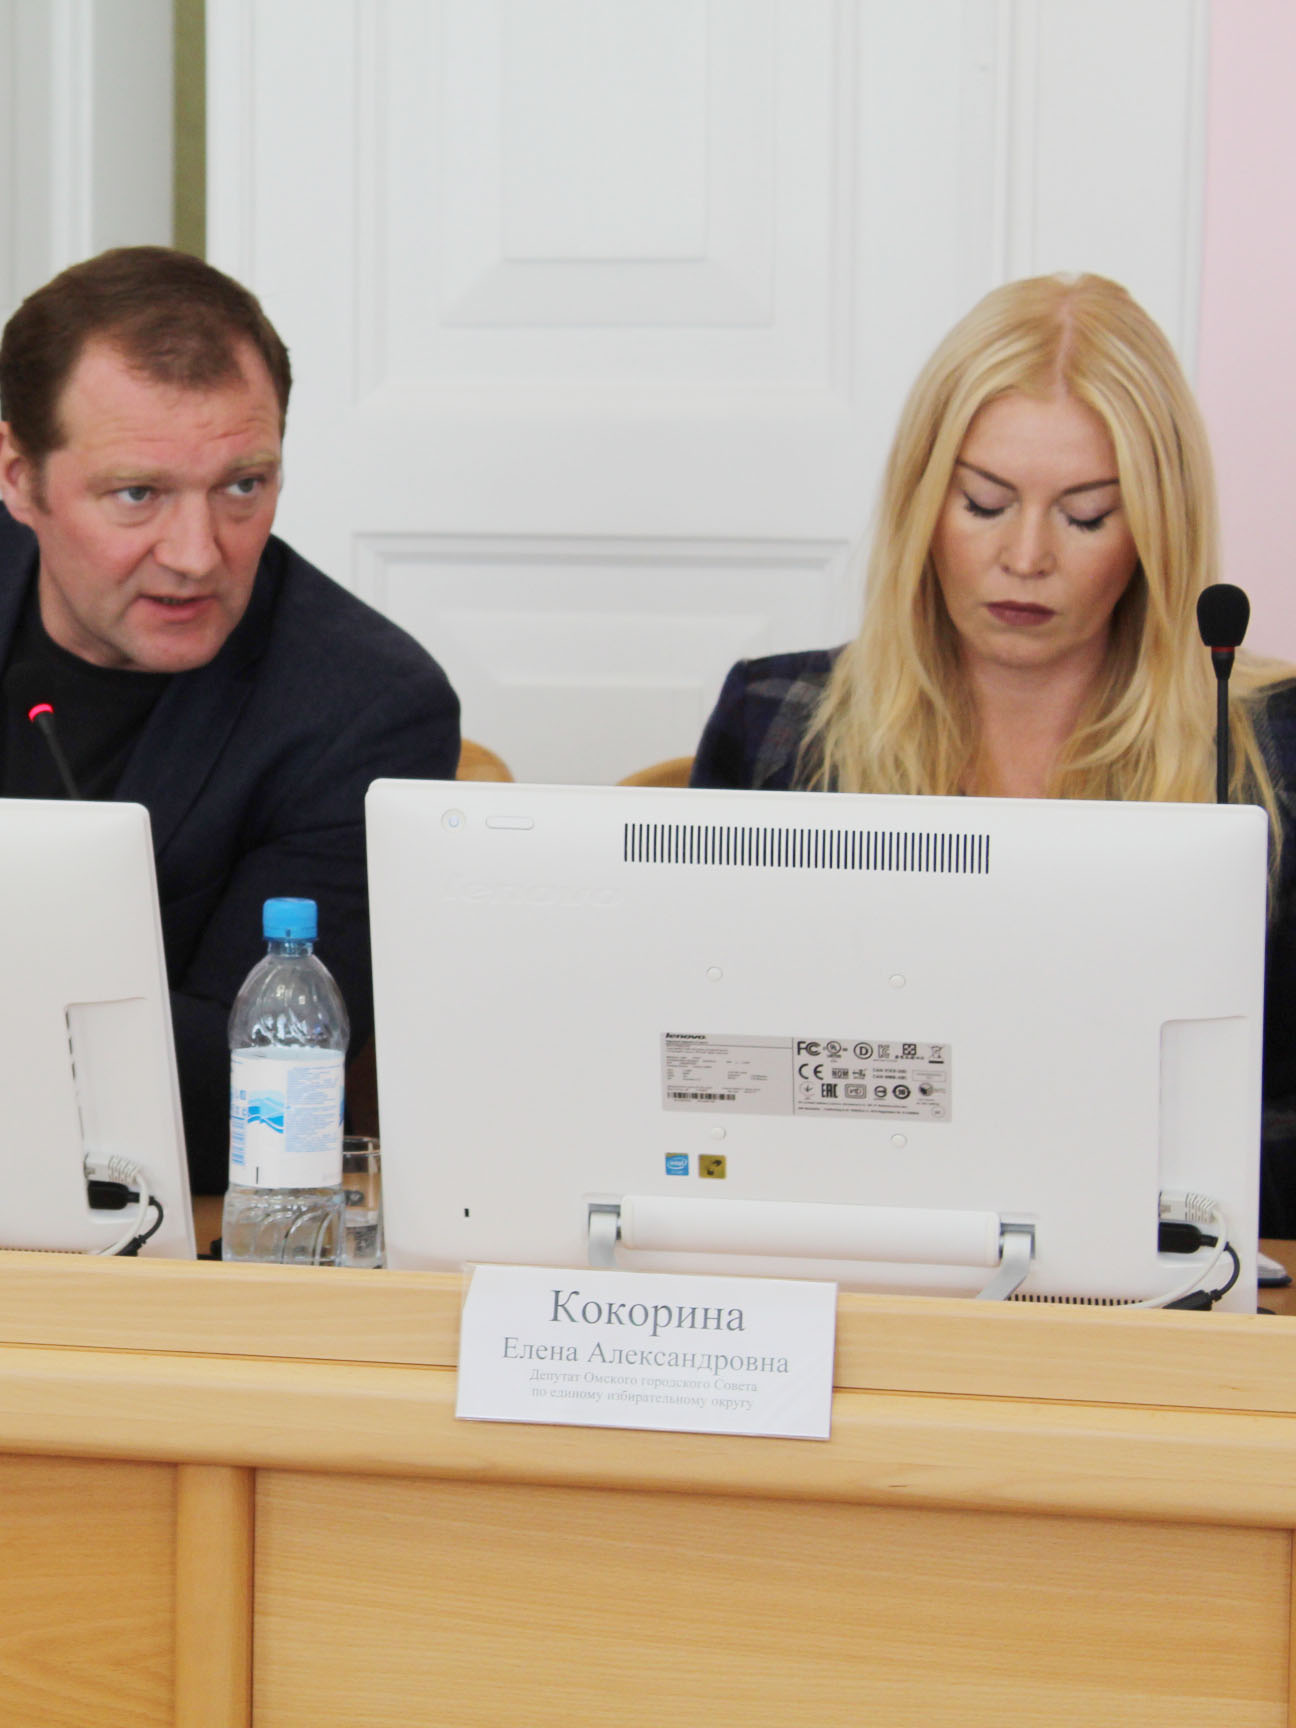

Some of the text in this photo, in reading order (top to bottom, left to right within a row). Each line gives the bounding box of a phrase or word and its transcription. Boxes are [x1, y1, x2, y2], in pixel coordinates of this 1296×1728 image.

[548, 1289, 746, 1337] Кокорина
[502, 1336, 789, 1376] Елена Александровна
[529, 1368, 758, 1392] Депутат Омского городского Совета
[531, 1388, 754, 1411] по единому избирательному округу
